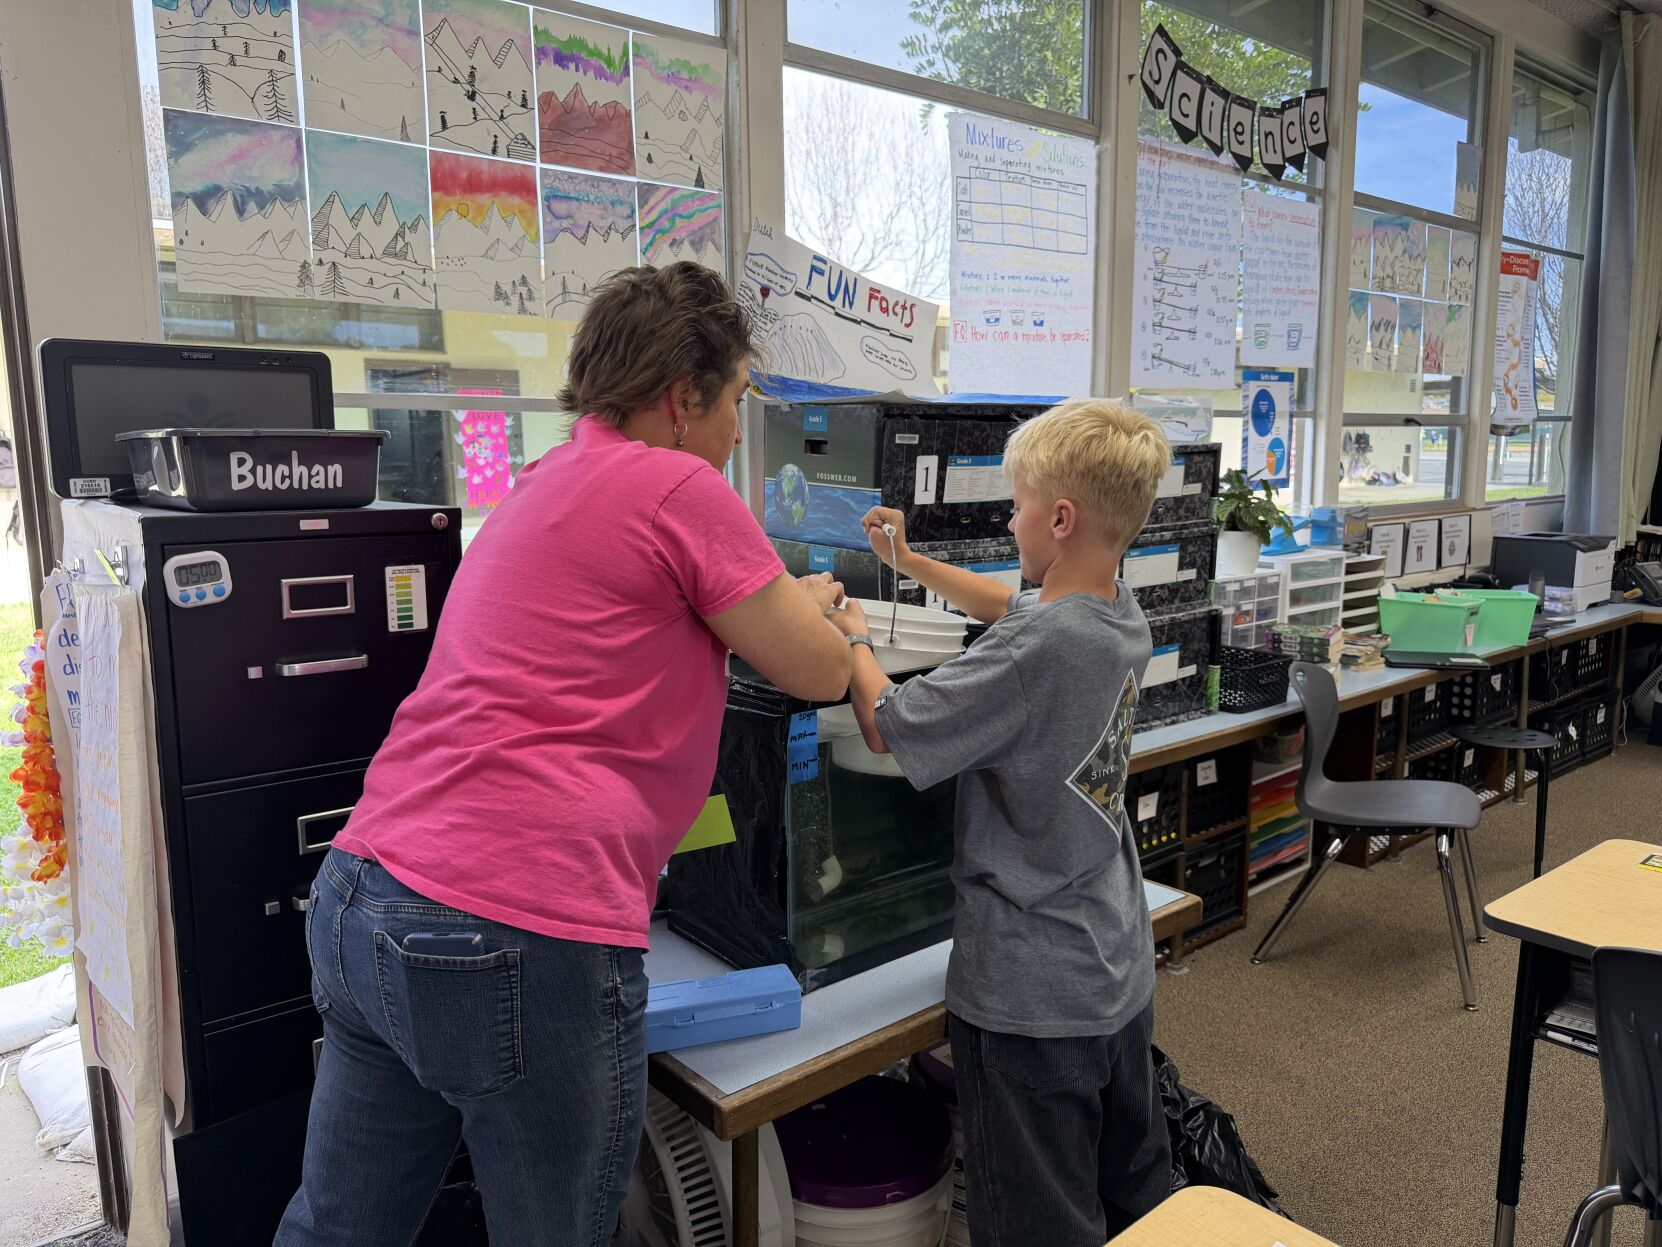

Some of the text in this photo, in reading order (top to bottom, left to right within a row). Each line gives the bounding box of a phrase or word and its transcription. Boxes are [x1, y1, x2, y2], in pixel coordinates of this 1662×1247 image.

[1148, 47, 1321, 155] Science
[966, 122, 1024, 152] Mixtures
[806, 254, 858, 310] FUN
[867, 286, 917, 329] Facts
[992, 329, 1010, 341] can
[1012, 330, 1019, 340] a
[472, 410, 501, 420] LOVE
[808, 415, 819, 423] Grade
[229, 450, 343, 491] Buchan
[816, 471, 857, 484] FOSSWEB.COM
[921, 466, 930, 493] 1
[814, 555, 825, 563] Grade
[790, 730, 808, 743] MAX
[791, 760, 809, 771] MIN
